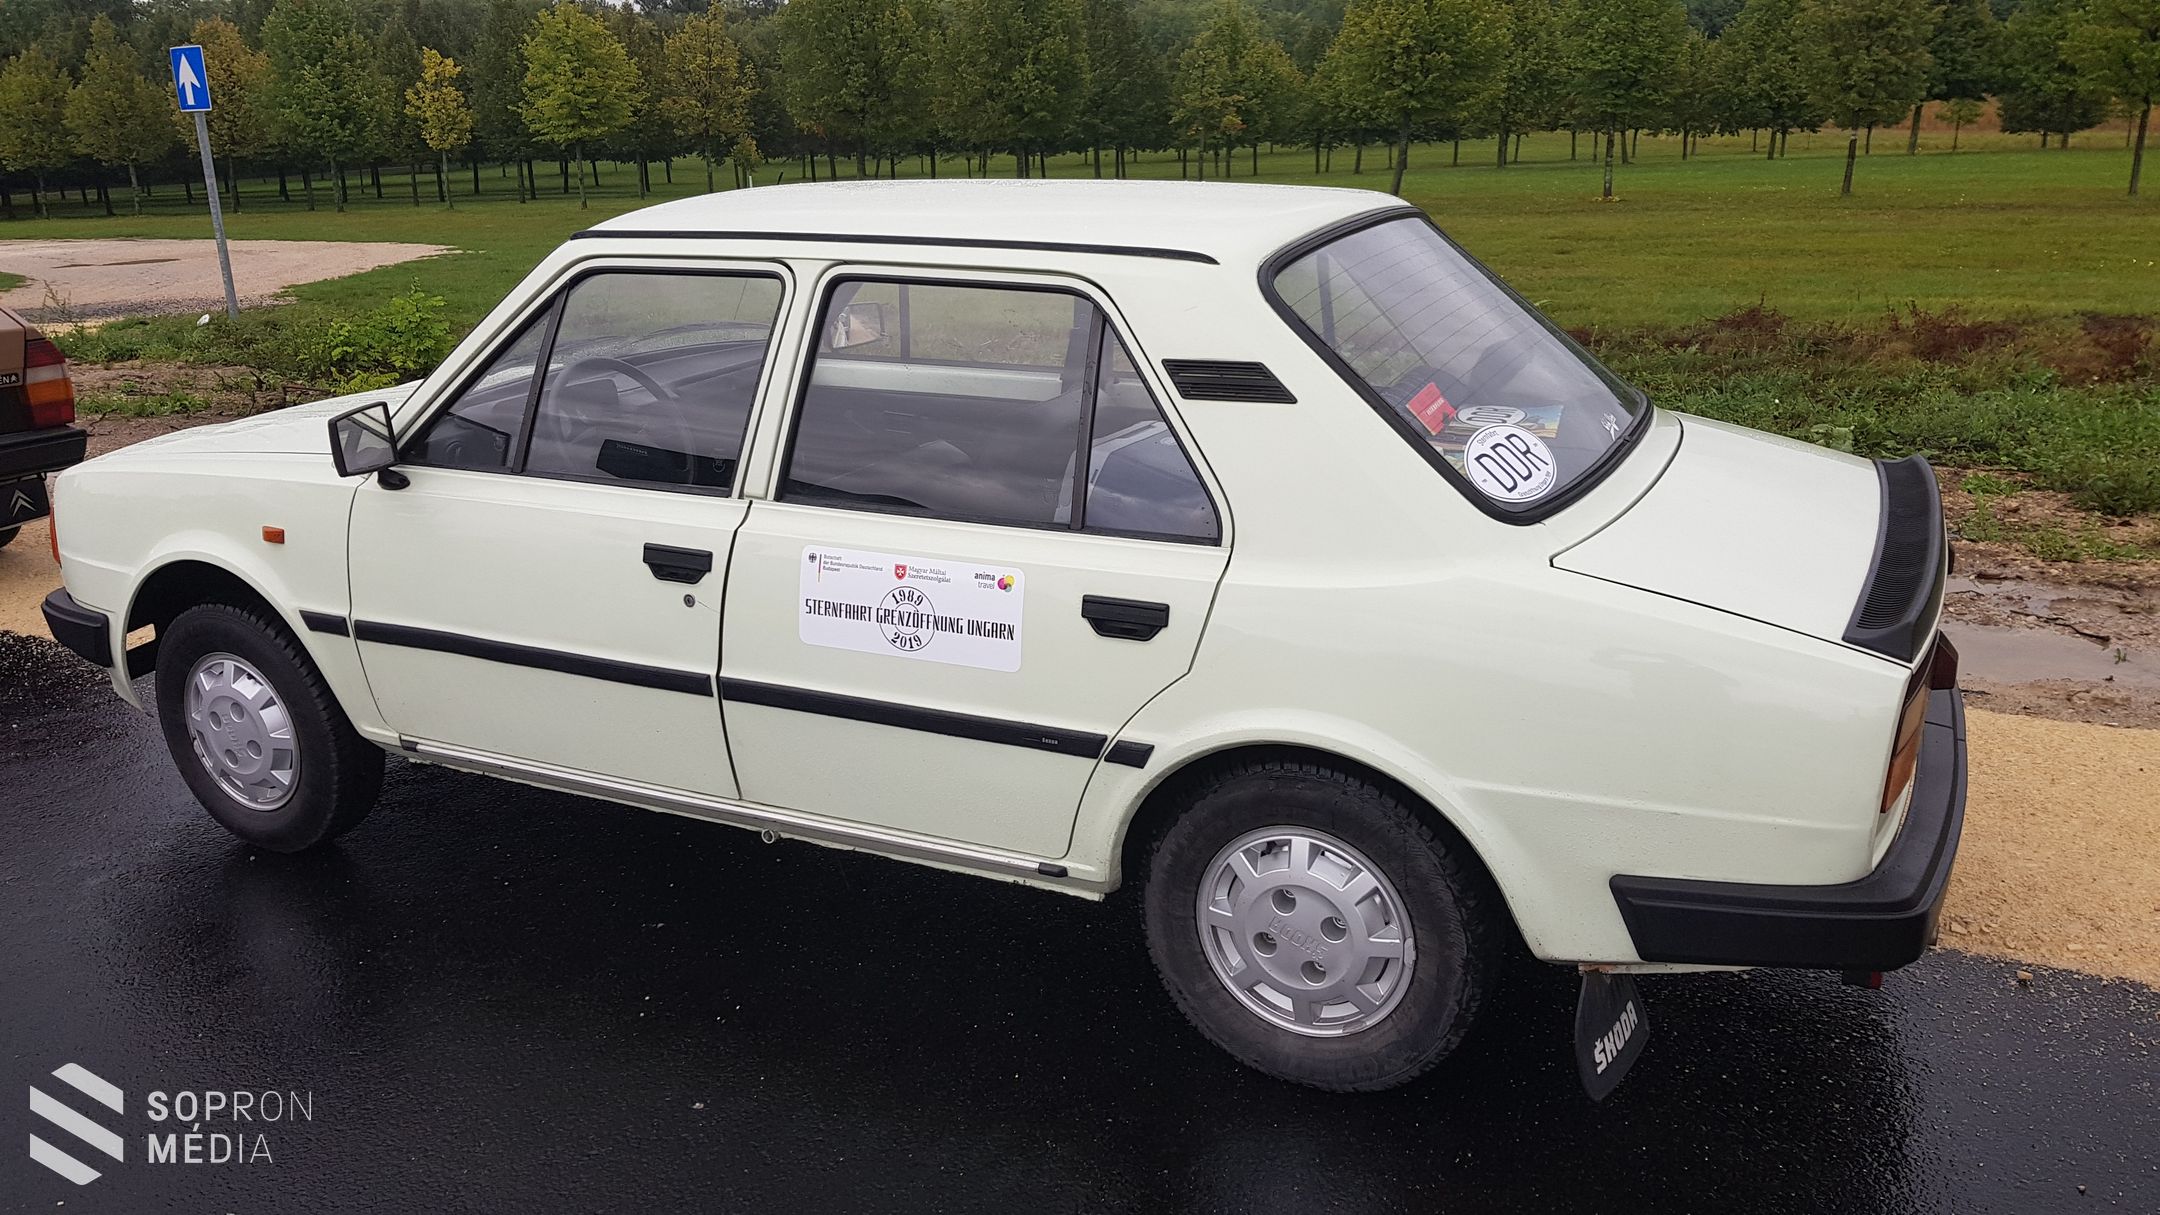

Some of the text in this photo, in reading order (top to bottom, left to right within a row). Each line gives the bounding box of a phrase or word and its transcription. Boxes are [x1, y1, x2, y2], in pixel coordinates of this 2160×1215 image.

[1474, 433, 1549, 493] DDR
[908, 566, 928, 575] Magyar
[974, 572, 996, 581] anima
[978, 581, 996, 589] travel
[891, 589, 924, 607] 1989
[805, 598, 1015, 641] STERNFAHRT GRENZÖFFNUNG UNGARN
[891, 631, 923, 649] 2019
